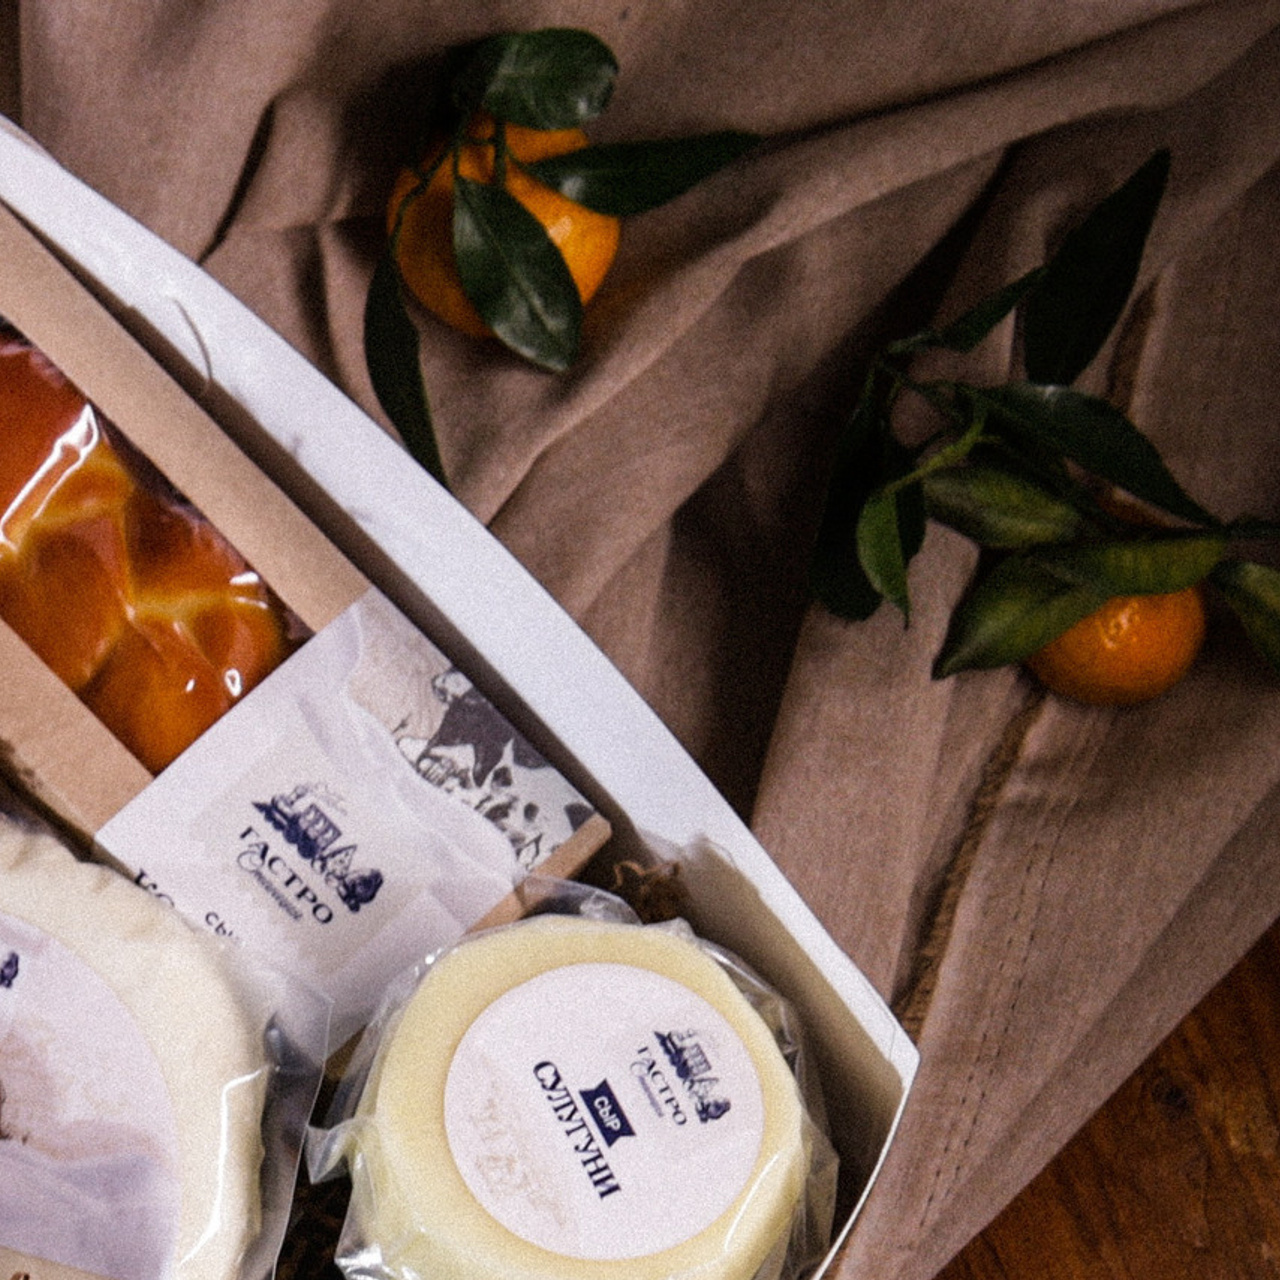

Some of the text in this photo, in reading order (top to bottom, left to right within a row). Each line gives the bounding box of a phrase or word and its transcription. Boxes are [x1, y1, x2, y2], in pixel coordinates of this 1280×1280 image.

[239, 826, 334, 925] ГАСТРО
[533, 1060, 622, 1200] СУЛУГУНИ
[637, 1046, 687, 1126] ГАСТРО
